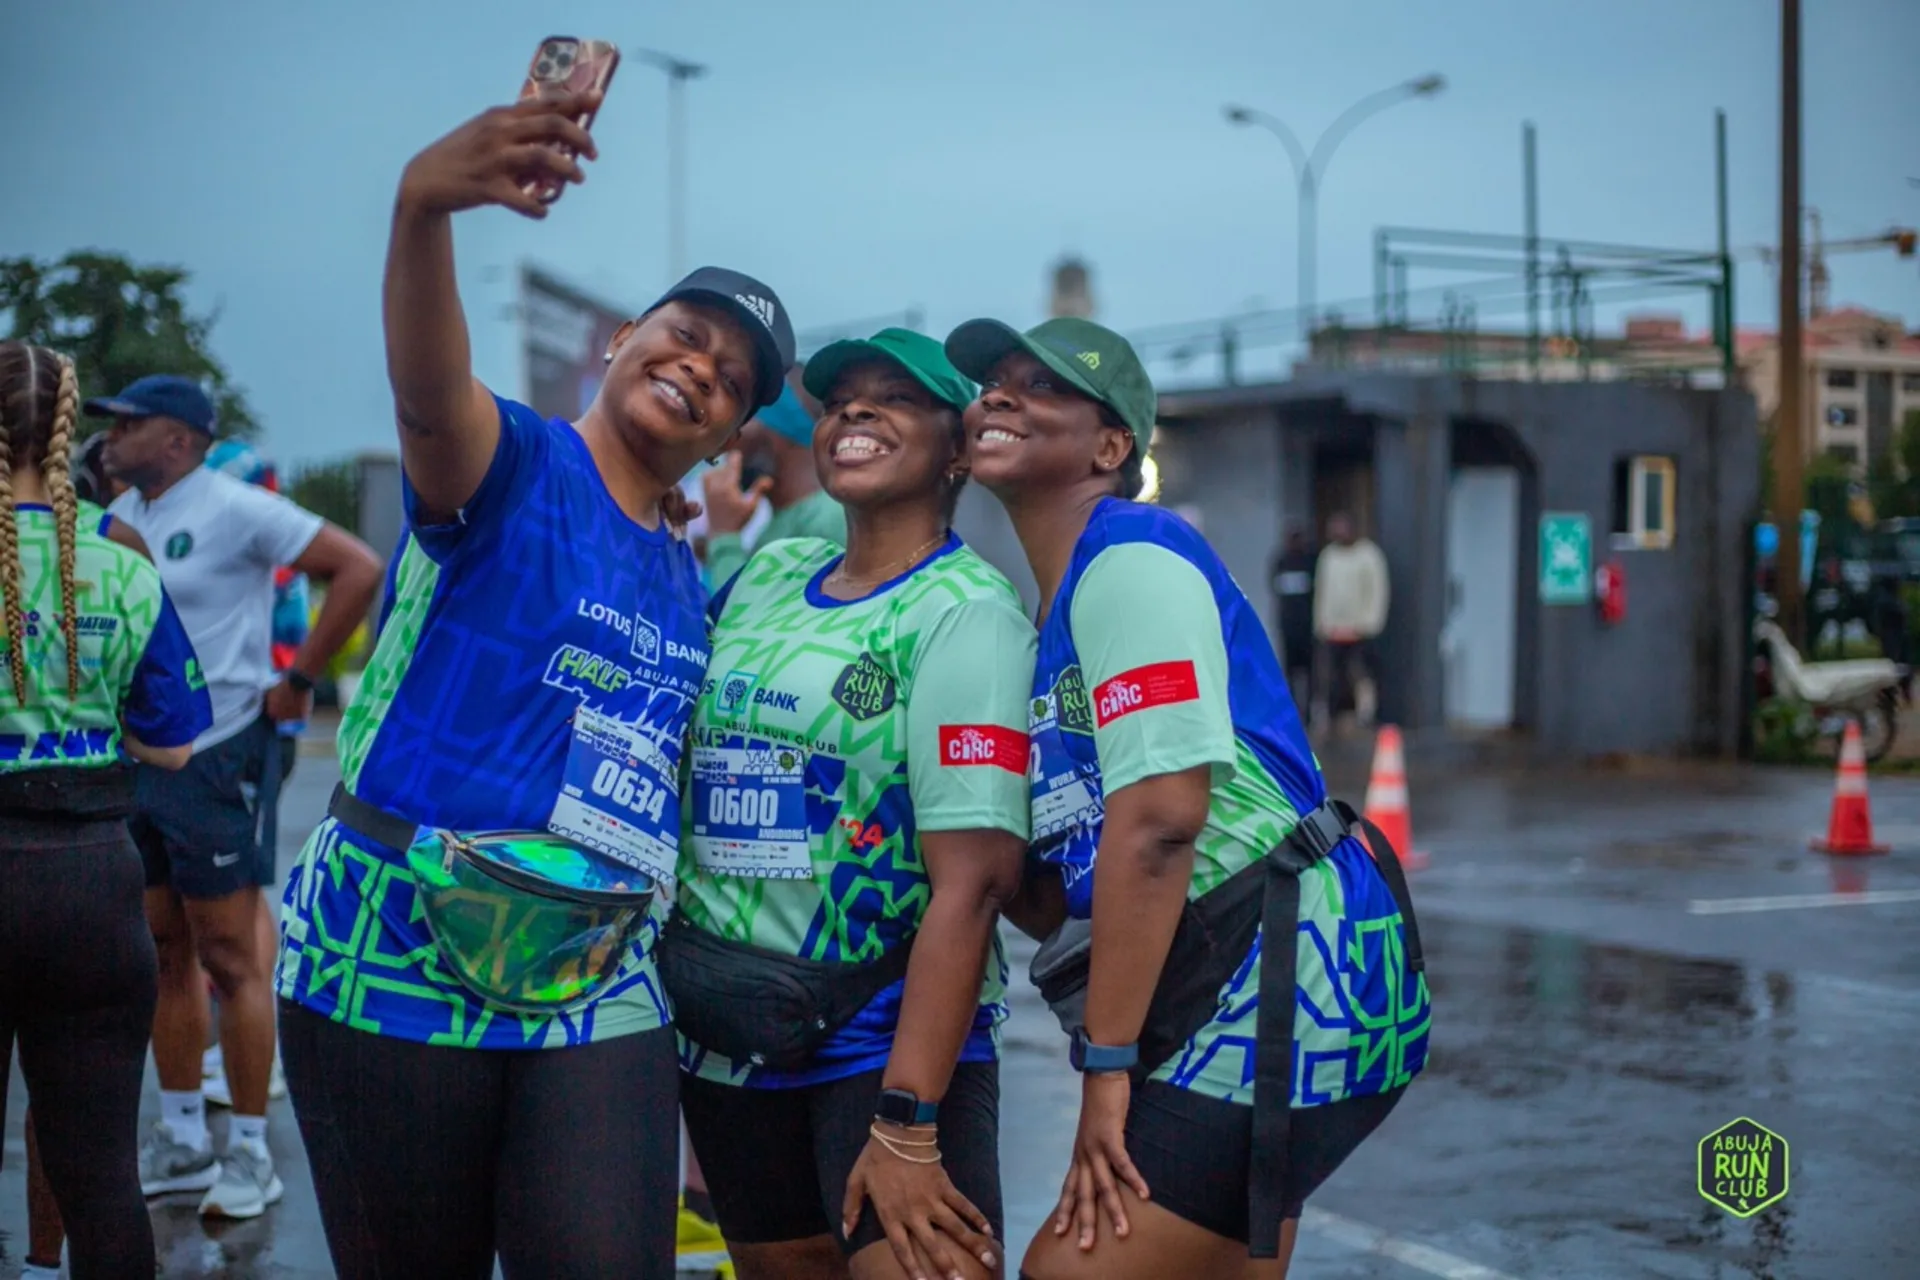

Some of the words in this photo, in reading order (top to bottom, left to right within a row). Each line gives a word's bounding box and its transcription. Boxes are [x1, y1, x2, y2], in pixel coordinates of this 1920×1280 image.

[577, 598, 632, 637] LOTUS
[665, 640, 707, 669] BANK
[557, 648, 629, 693] HALF
[634, 666, 679, 688] ABUJA
[844, 671, 887, 697] RUN
[753, 687, 800, 713] BANK
[841, 692, 883, 712] CLUB
[725, 720, 760, 735] ABUJA
[764, 728, 789, 742] RUN
[794, 735, 837, 754] CLUB
[592, 759, 668, 824] 0634
[709, 786, 779, 827] 0600
